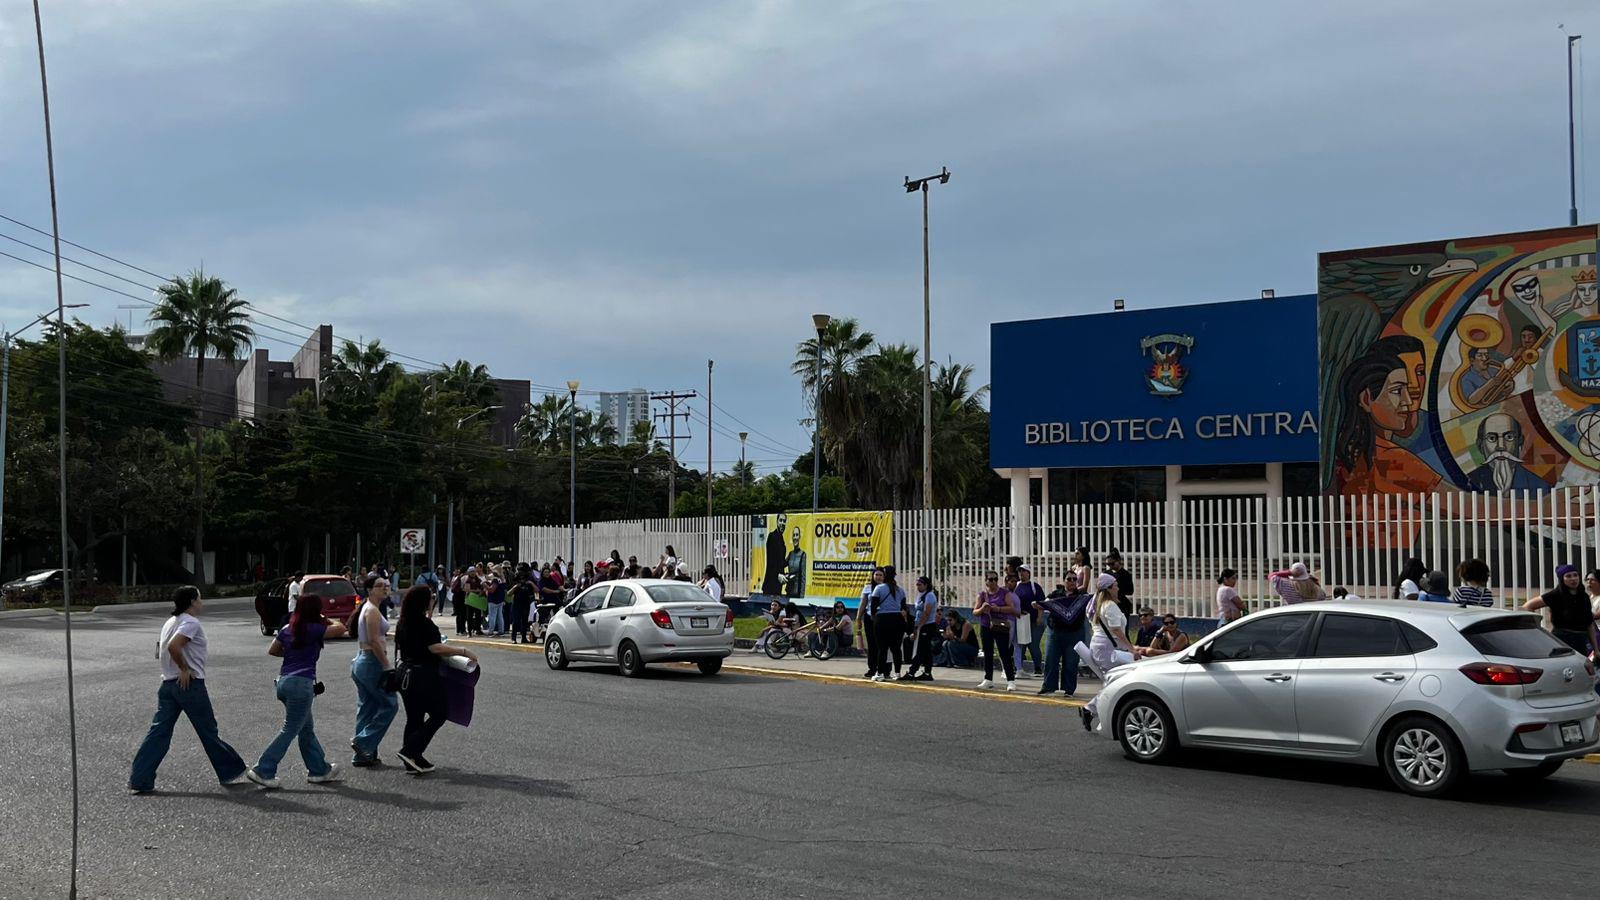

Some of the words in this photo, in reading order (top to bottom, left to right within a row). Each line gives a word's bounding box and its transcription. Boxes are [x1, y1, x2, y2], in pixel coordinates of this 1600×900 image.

[1581, 379, 1600, 388] MAZ
[1025, 417, 1184, 445] BIBLIOTECA
[1194, 410, 1319, 439] CENTRA
[815, 522, 874, 538] ORGULLO
[814, 538, 849, 559] UAS
